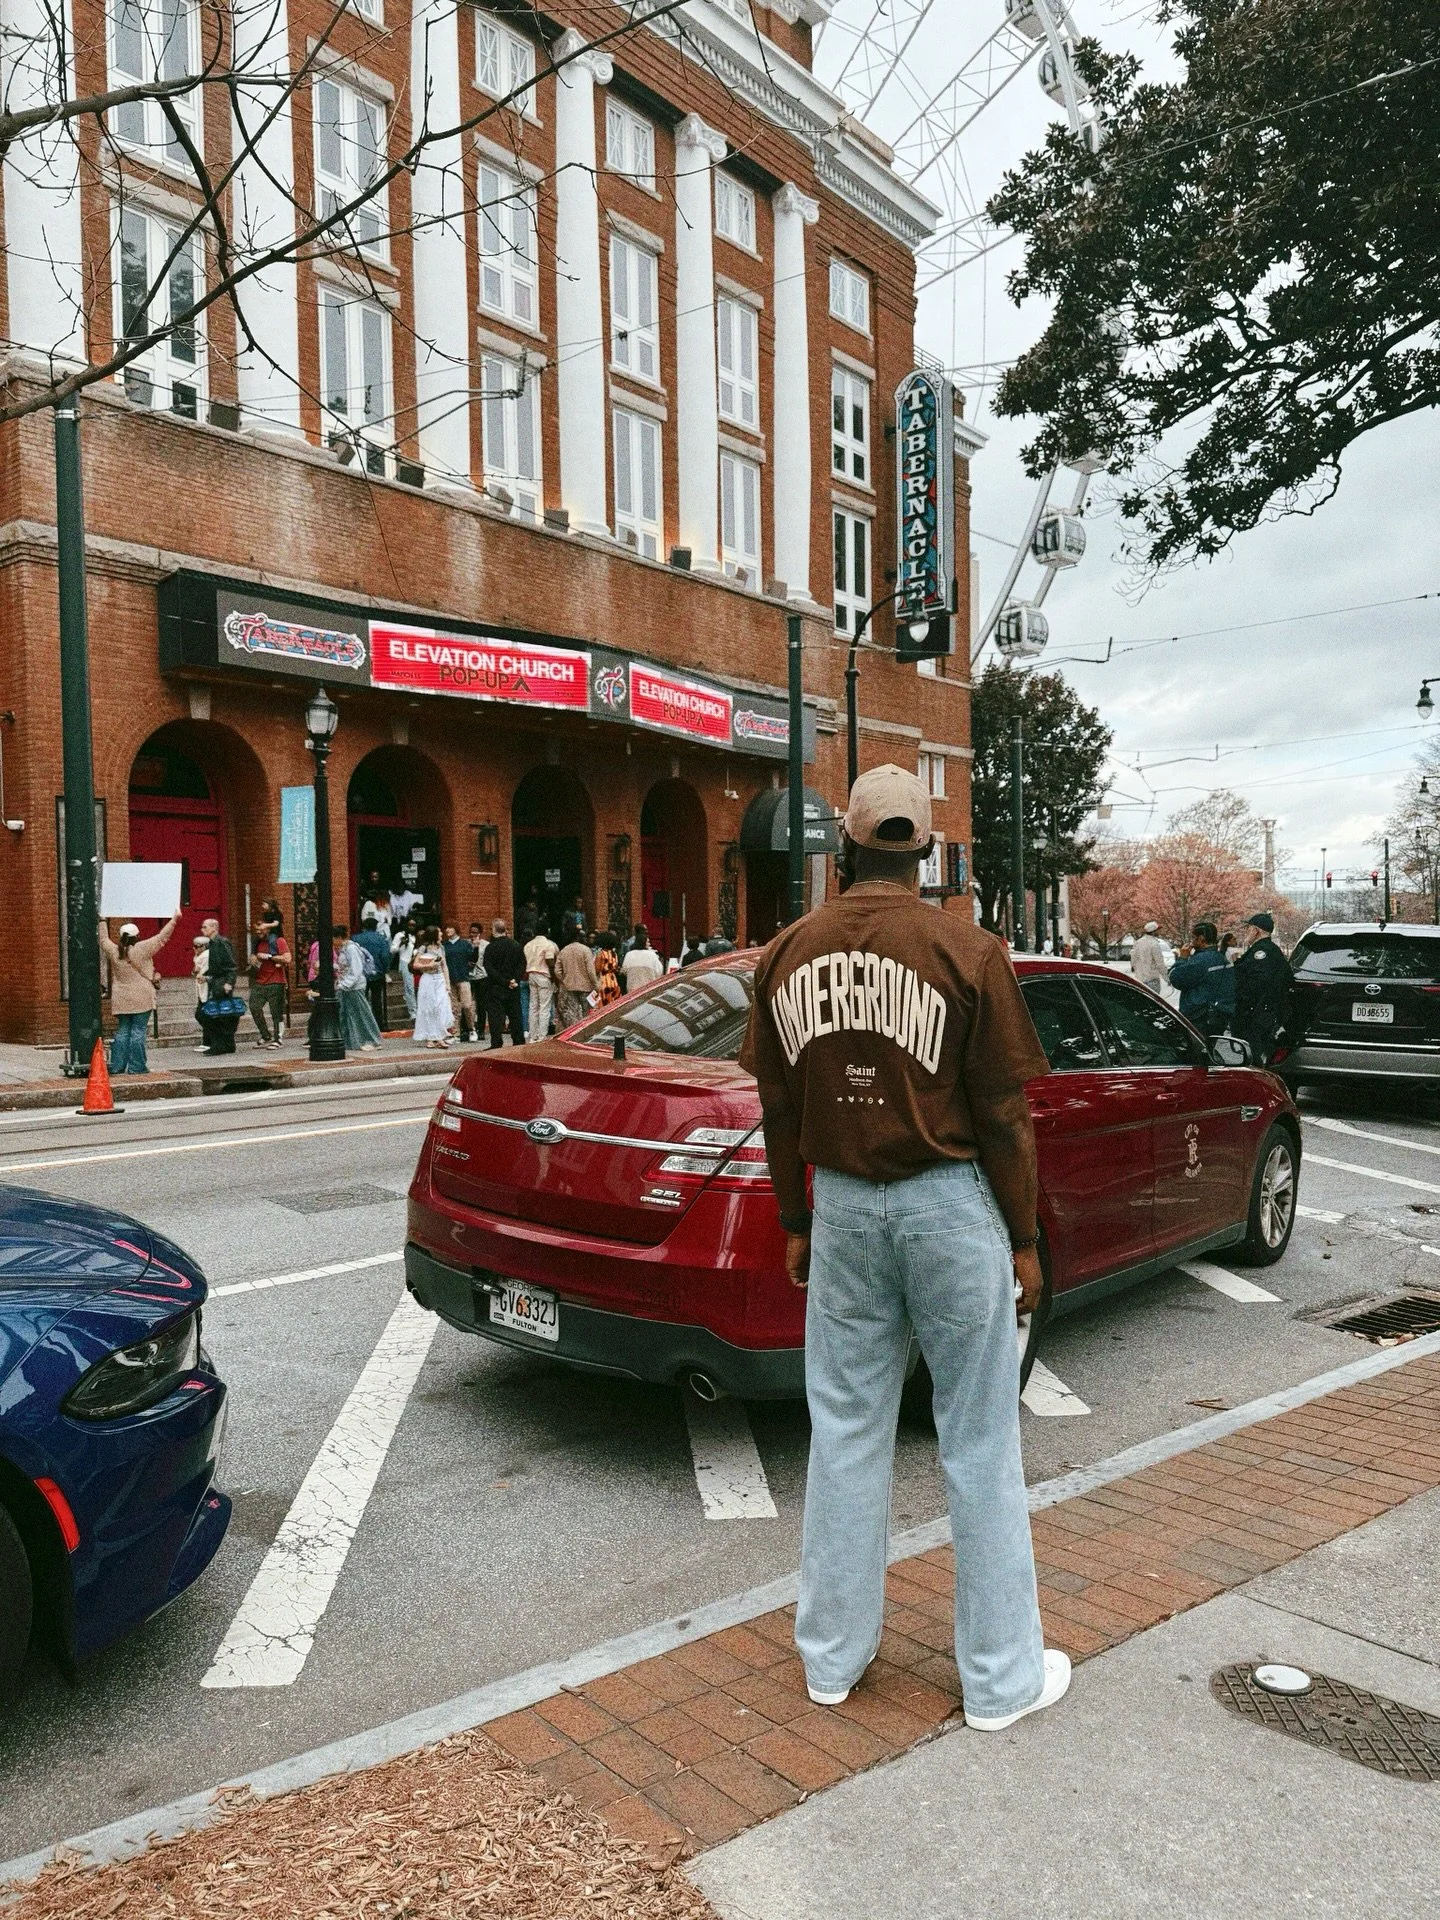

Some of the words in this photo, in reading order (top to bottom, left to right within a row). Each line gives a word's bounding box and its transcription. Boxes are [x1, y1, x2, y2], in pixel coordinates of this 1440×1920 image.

[906, 386, 928, 600] TABERNACLE
[389, 639, 495, 671] ELEVATION
[499, 655, 574, 682] CHURCH
[440, 665, 509, 690] POP-UP
[639, 680, 689, 708] ELEVATION
[690, 695, 725, 719] CHURCH
[663, 703, 696, 724] POP-UP
[771, 950, 947, 1075] UNDERGROUND
[845, 1064, 876, 1076] Saint
[530, 1121, 550, 1135] Ford
[512, 1318, 537, 1332] FULTON
